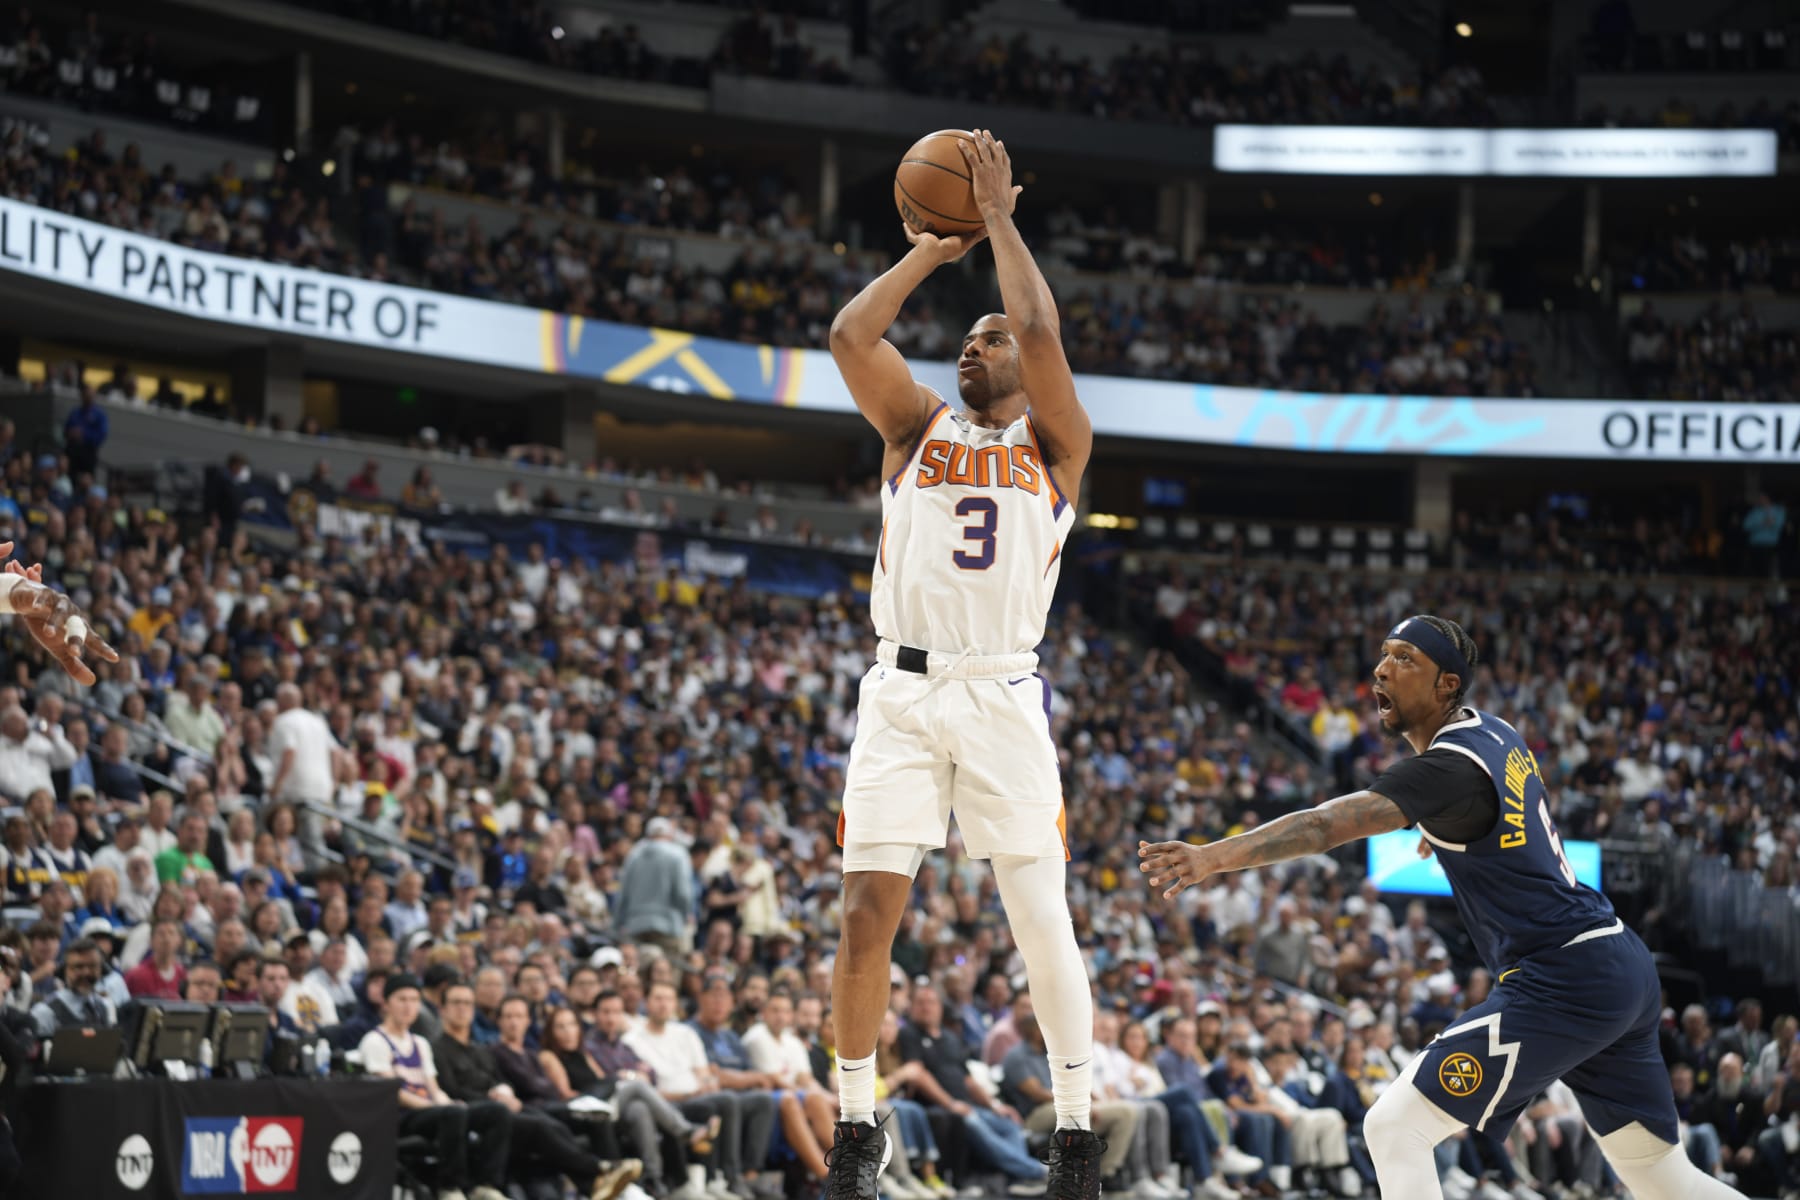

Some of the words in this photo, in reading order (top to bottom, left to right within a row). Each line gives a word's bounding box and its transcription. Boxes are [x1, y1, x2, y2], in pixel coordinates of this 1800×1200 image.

[1, 211, 105, 279] LITY
[122, 243, 353, 332] PARTNER
[373, 295, 440, 342] OF
[916, 439, 1041, 496] SUNS
[952, 496, 998, 571] 3
[190, 1131, 227, 1178] NBA
